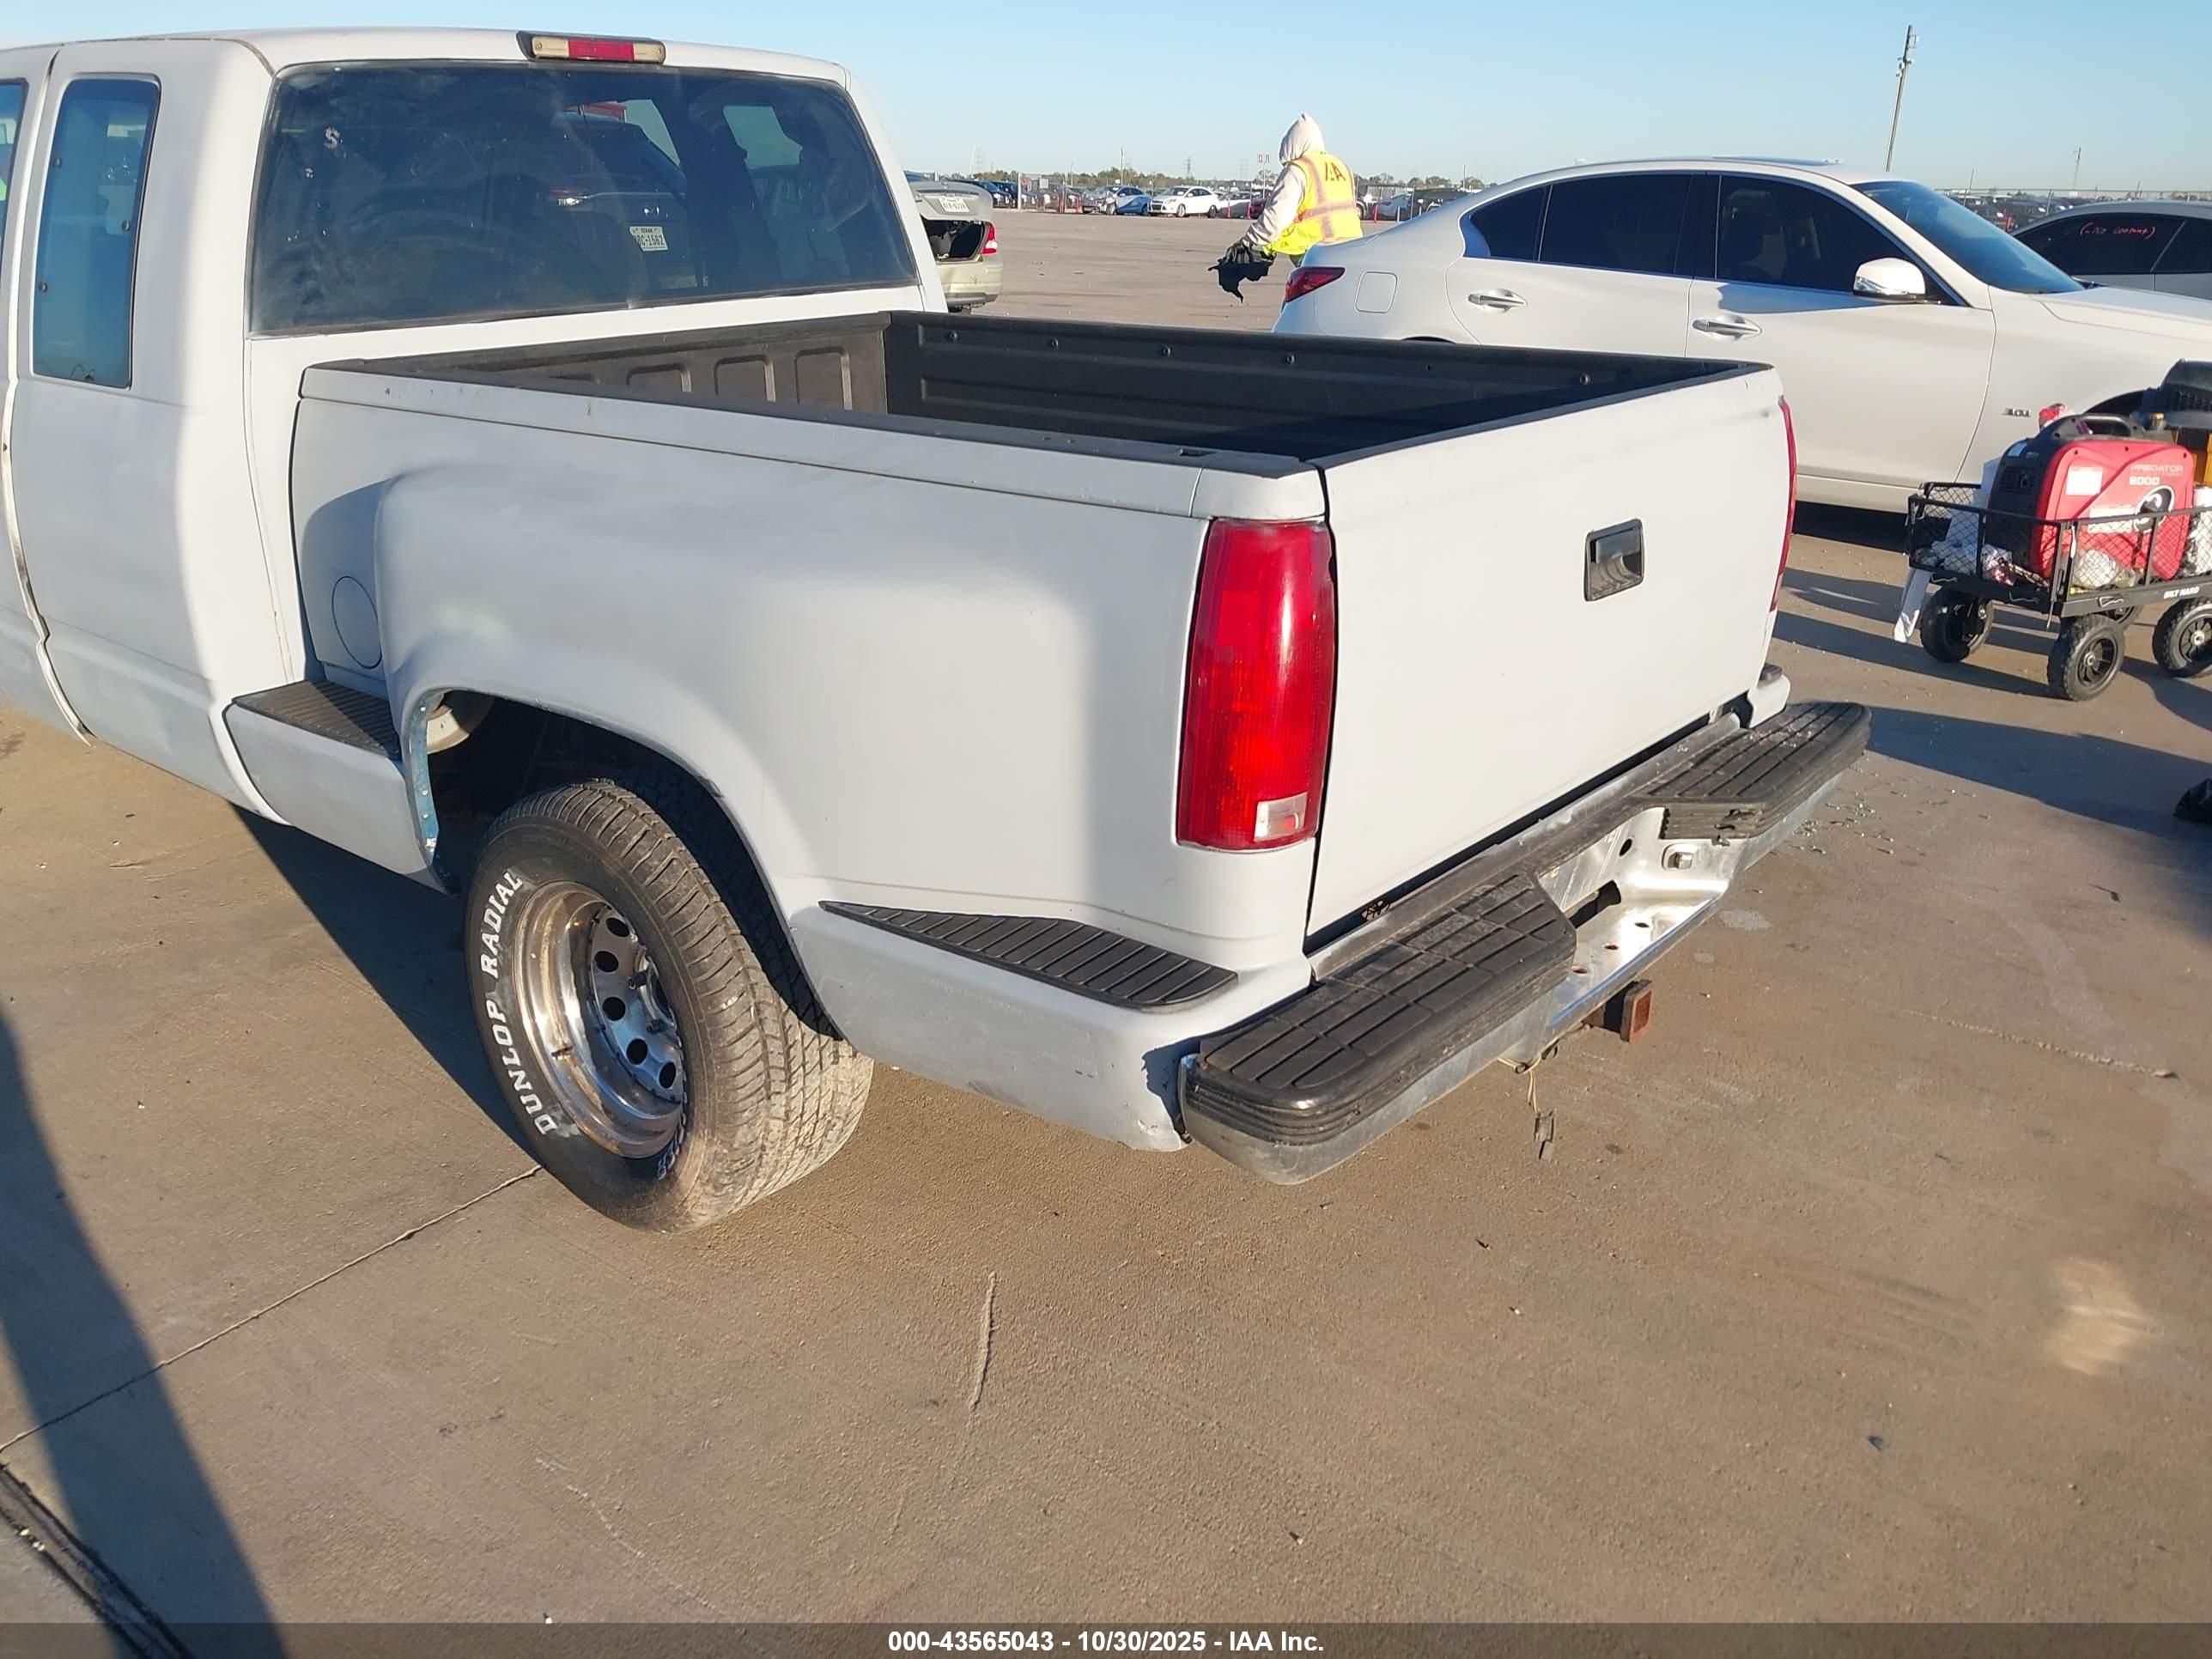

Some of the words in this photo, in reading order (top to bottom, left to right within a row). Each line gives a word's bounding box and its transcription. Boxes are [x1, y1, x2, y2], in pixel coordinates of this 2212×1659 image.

[2131, 464, 2185, 472] PREDATOR
[480, 872, 523, 979] RADIAL
[485, 999, 558, 1135] DUNLOP
